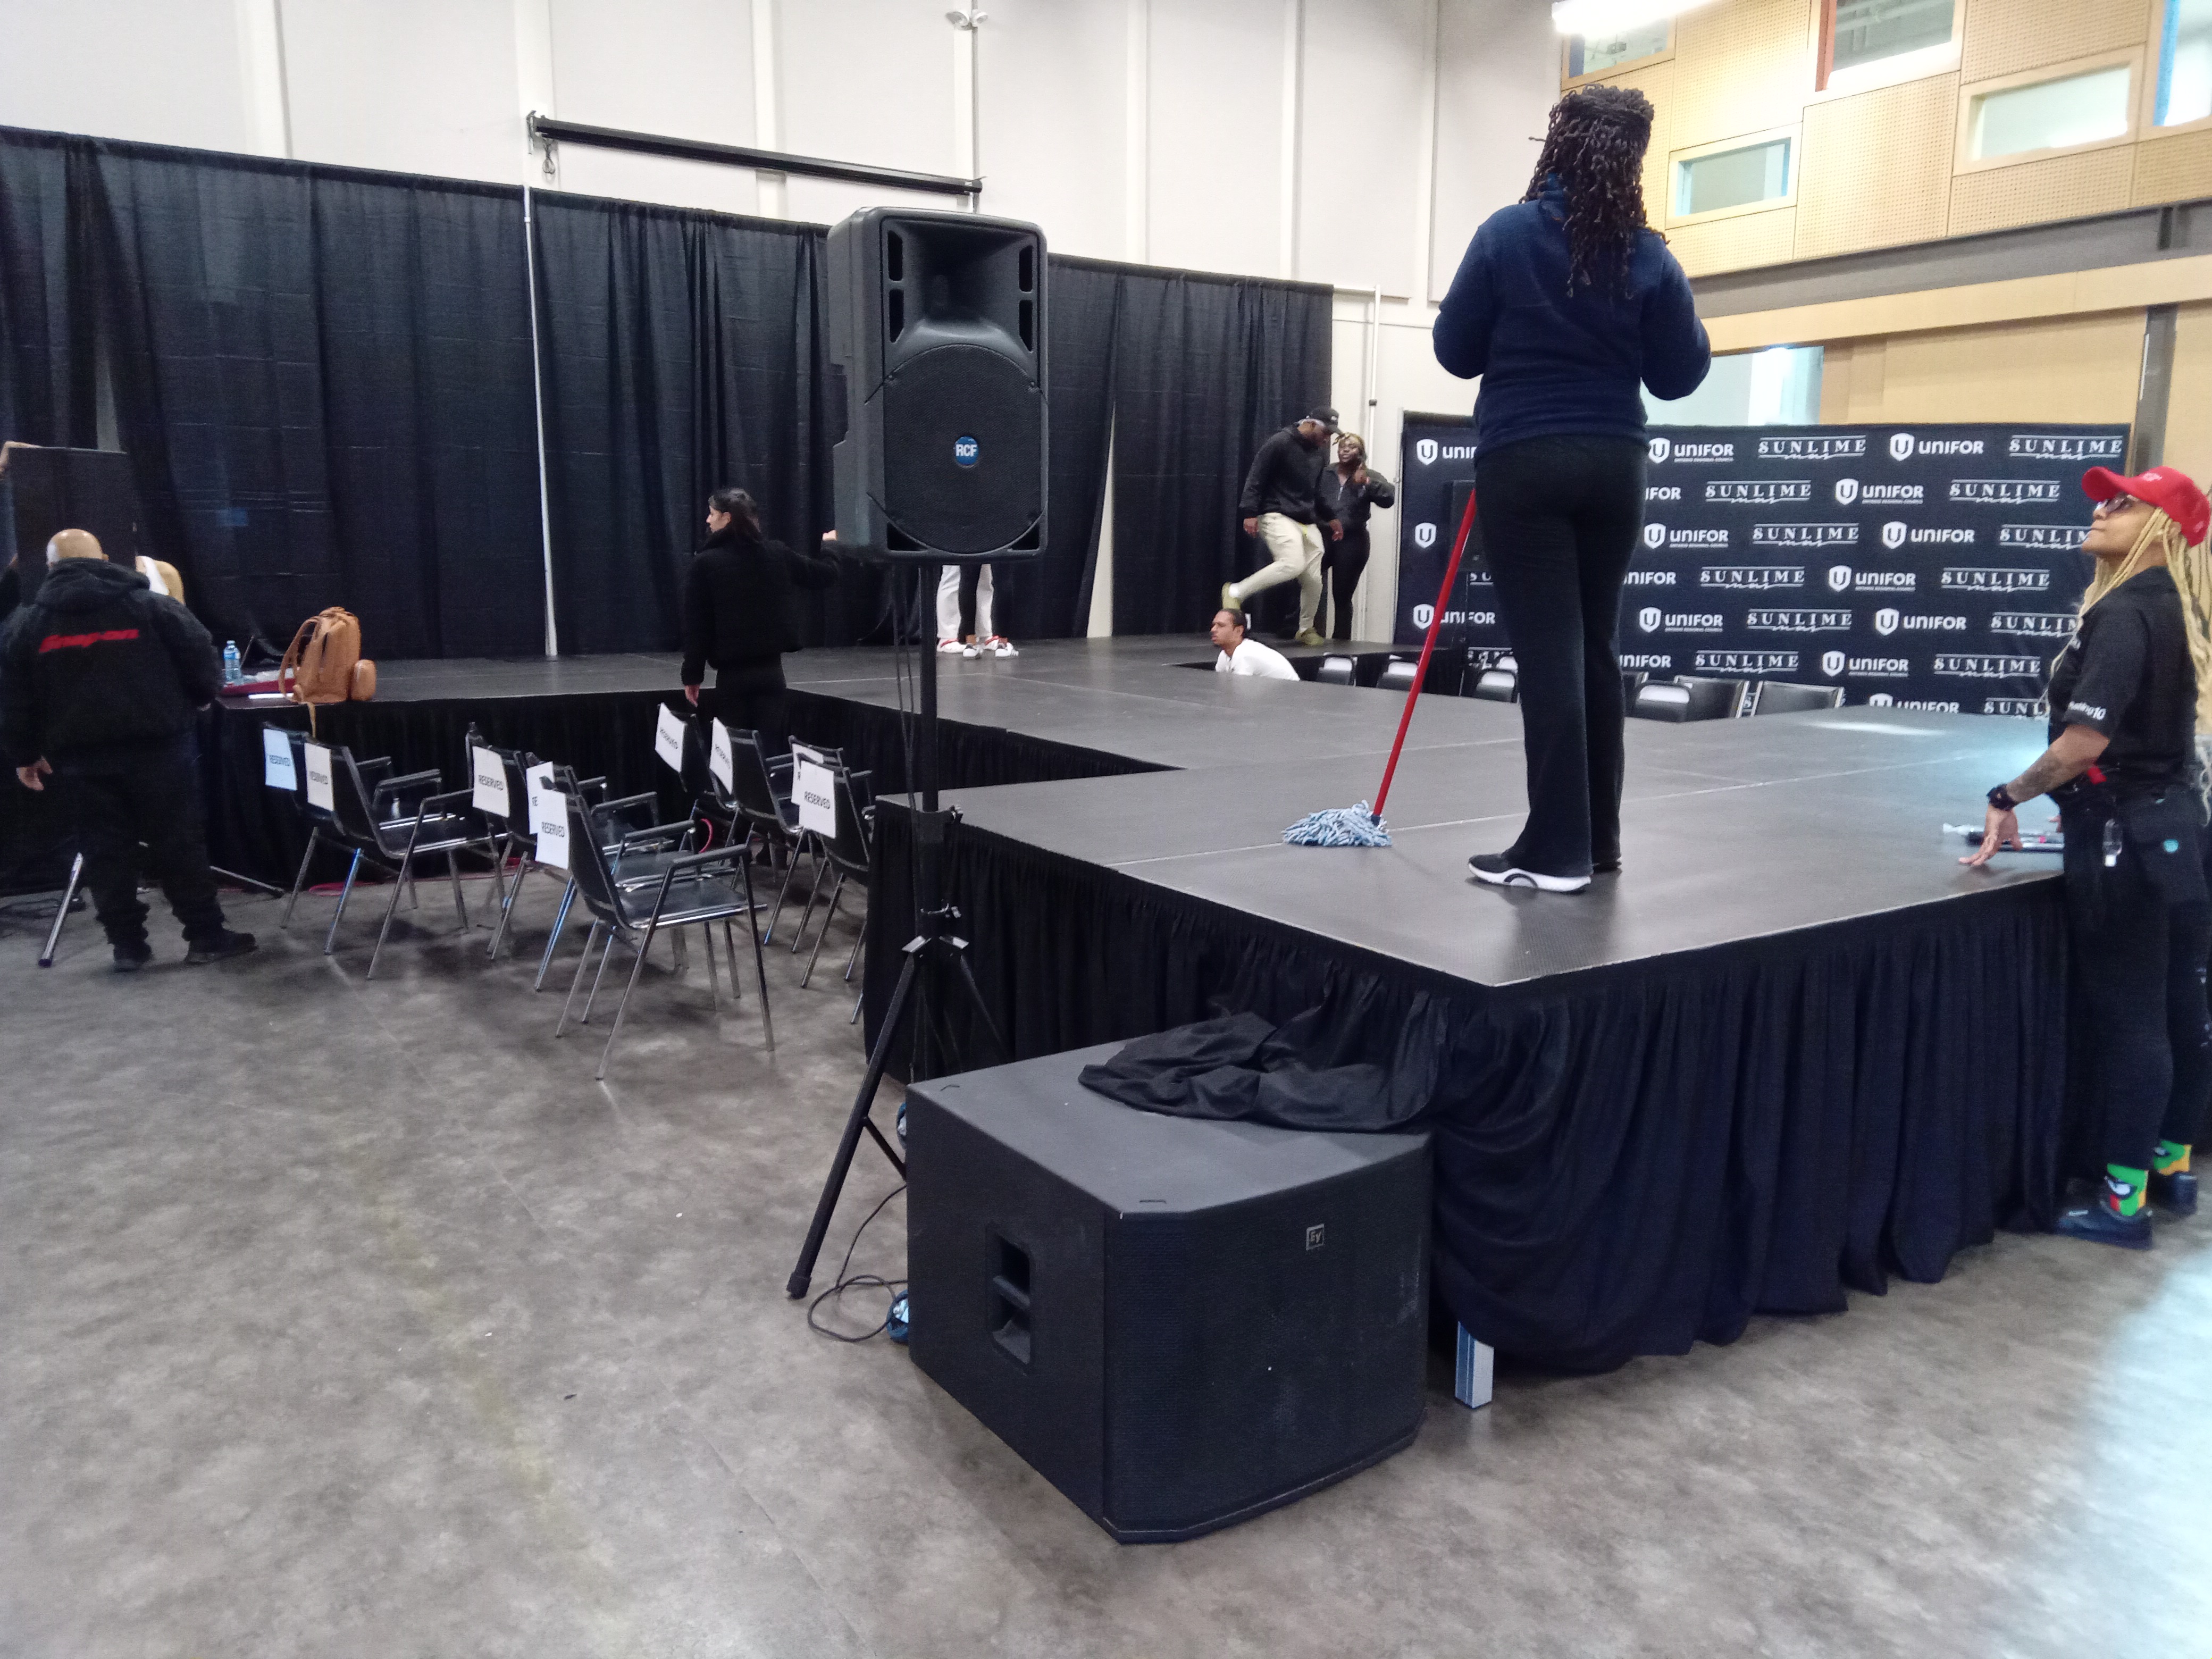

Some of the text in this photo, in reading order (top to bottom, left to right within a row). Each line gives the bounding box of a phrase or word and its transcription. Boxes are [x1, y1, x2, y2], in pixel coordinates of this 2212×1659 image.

[956, 444, 977, 456] RCF
[1674, 444, 1734, 456] UNIFOR
[1758, 439, 1866, 454] SUNLIME
[1918, 441, 1983, 454] UNIFOR
[2009, 439, 2123, 453] SUNLIME
[1645, 487, 1681, 500] IFOR
[1705, 484, 1811, 498] SUNLIME
[1863, 485, 1924, 498] UNIFOR
[1949, 483, 2060, 497] SUNLIME
[1670, 530, 1729, 542] UNIFOR
[1753, 527, 1859, 540] SUNLIME
[1911, 529, 1975, 543] UNIFOR
[2000, 529, 2088, 542] SUNLIM
[1624, 571, 1677, 585] NIFOR
[1700, 570, 1805, 583] SUNLIME
[1855, 572, 1916, 585] UNIFOR
[1941, 572, 2049, 586] SUNLIME
[1665, 614, 1723, 626] UNIFOR
[1747, 613, 1852, 626] SUNLIME
[1903, 616, 1967, 630] UNIFOR
[1695, 655, 1799, 667] SUNLIME
[1849, 658, 1909, 672] UNIFOR
[1934, 658, 2041, 673] SUNLIME
[479, 775, 504, 791] RESERVED
[805, 791, 831, 809] RESERVED
[541, 822, 565, 837] RESERVED
